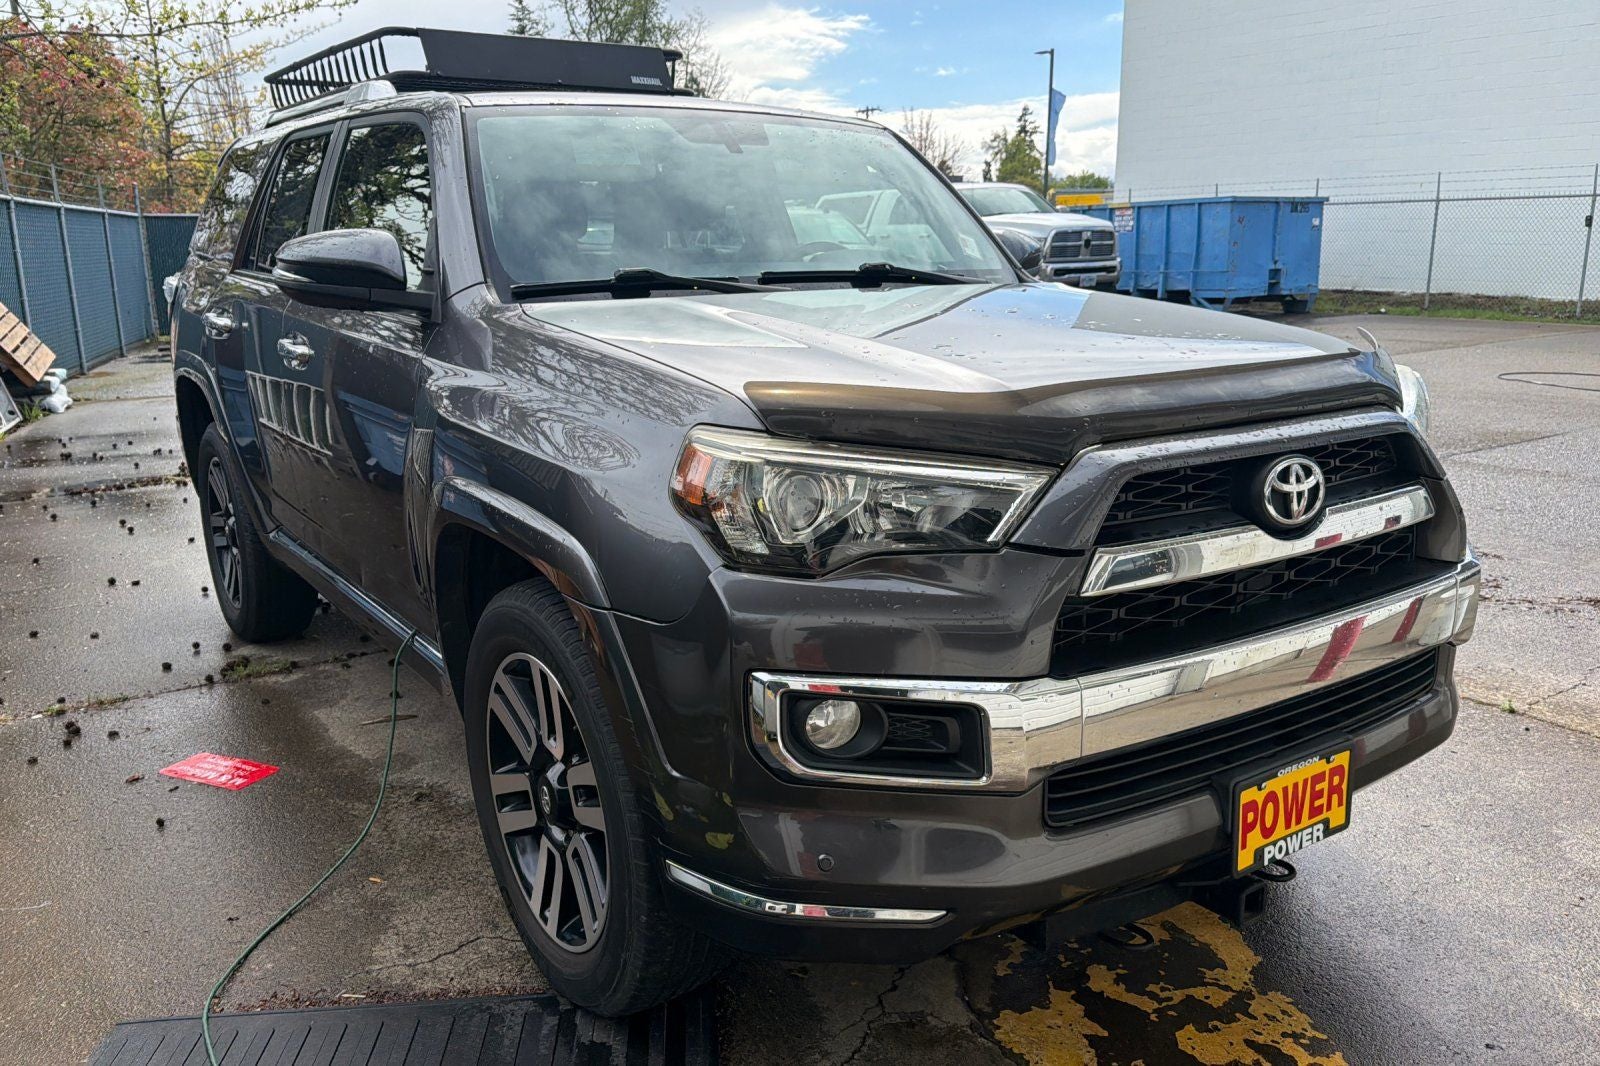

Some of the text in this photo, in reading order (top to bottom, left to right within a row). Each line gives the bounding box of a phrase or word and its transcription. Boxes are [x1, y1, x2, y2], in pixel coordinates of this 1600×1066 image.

[1277, 755, 1320, 777] OREGON
[1240, 764, 1346, 851] POWER
[1263, 823, 1324, 867] POWER
